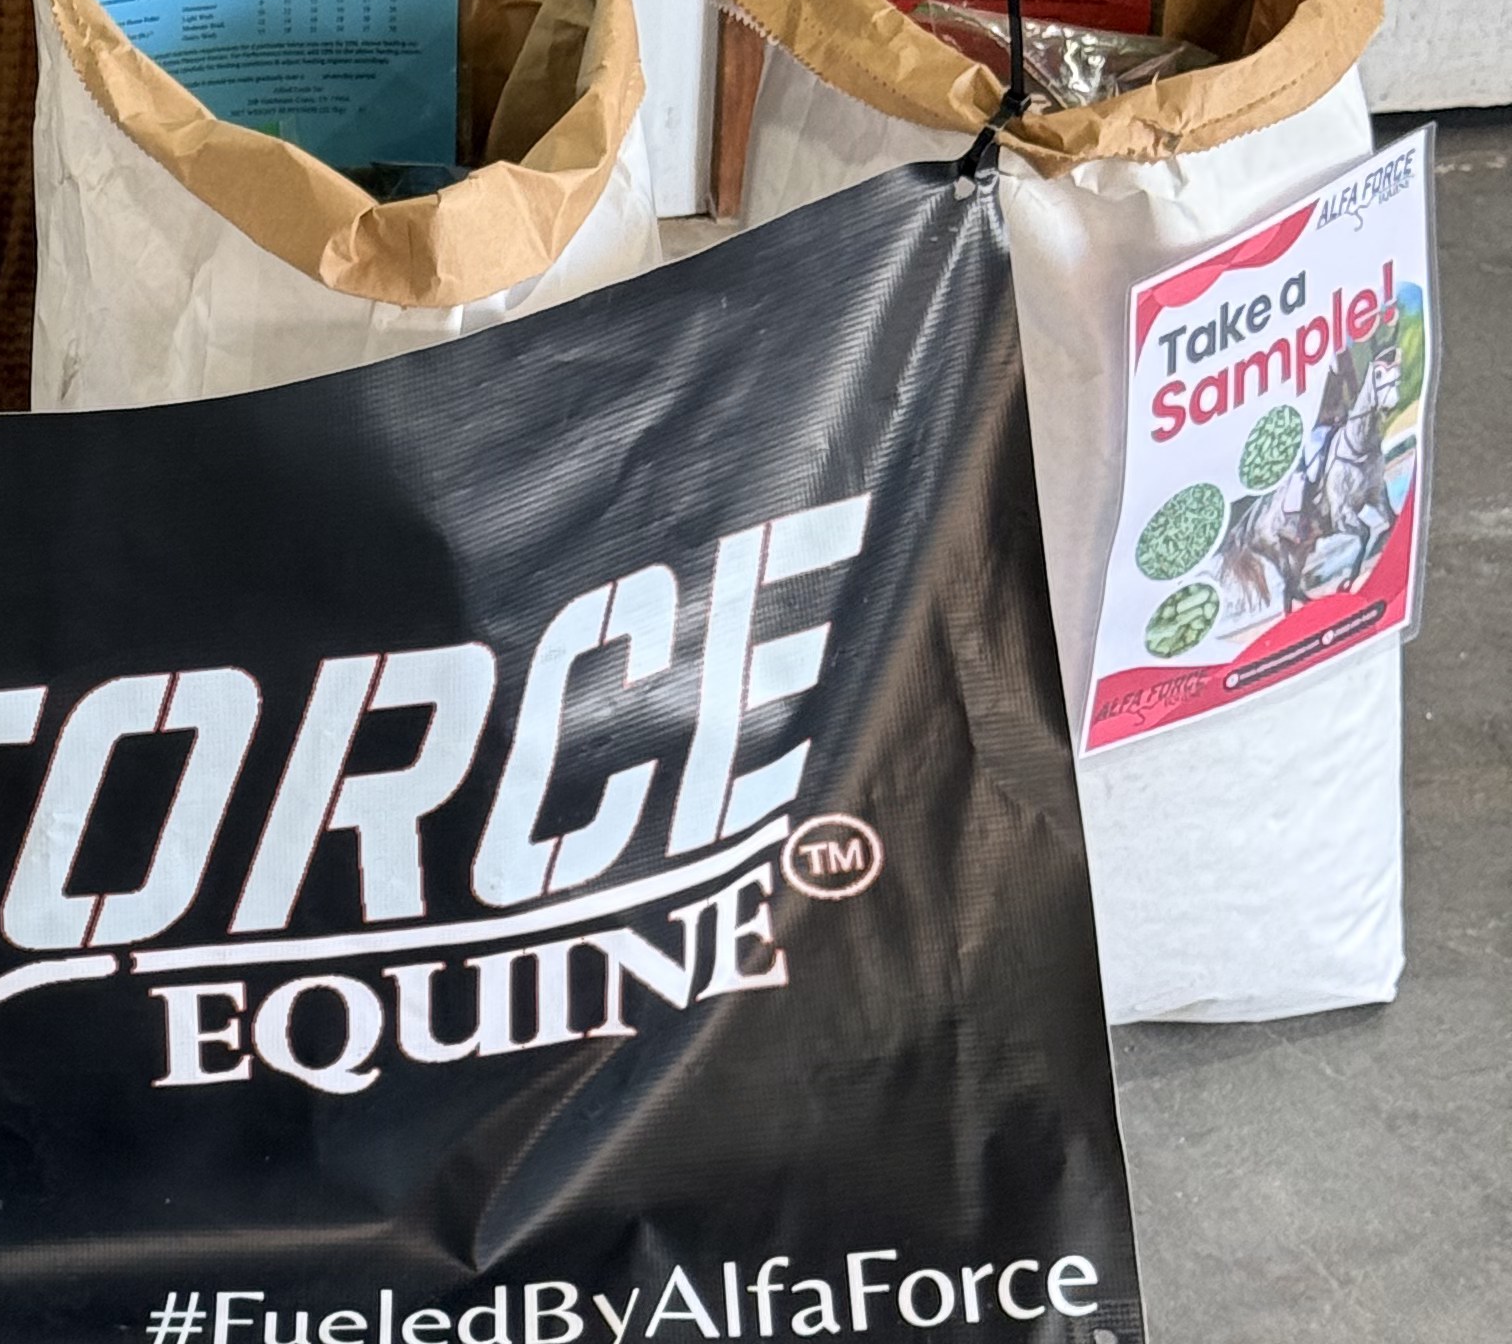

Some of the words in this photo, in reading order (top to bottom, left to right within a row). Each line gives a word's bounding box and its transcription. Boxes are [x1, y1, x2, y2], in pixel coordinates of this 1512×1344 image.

[1316, 181, 1358, 230] ALFA
[1361, 148, 1416, 201] FORCE
[1151, 259, 1397, 443] Sample!
[1158, 294, 1272, 376] Take
[1279, 270, 1306, 315] a
[798, 837, 865, 875] TM
[150, 861, 788, 1094] EQUINE
